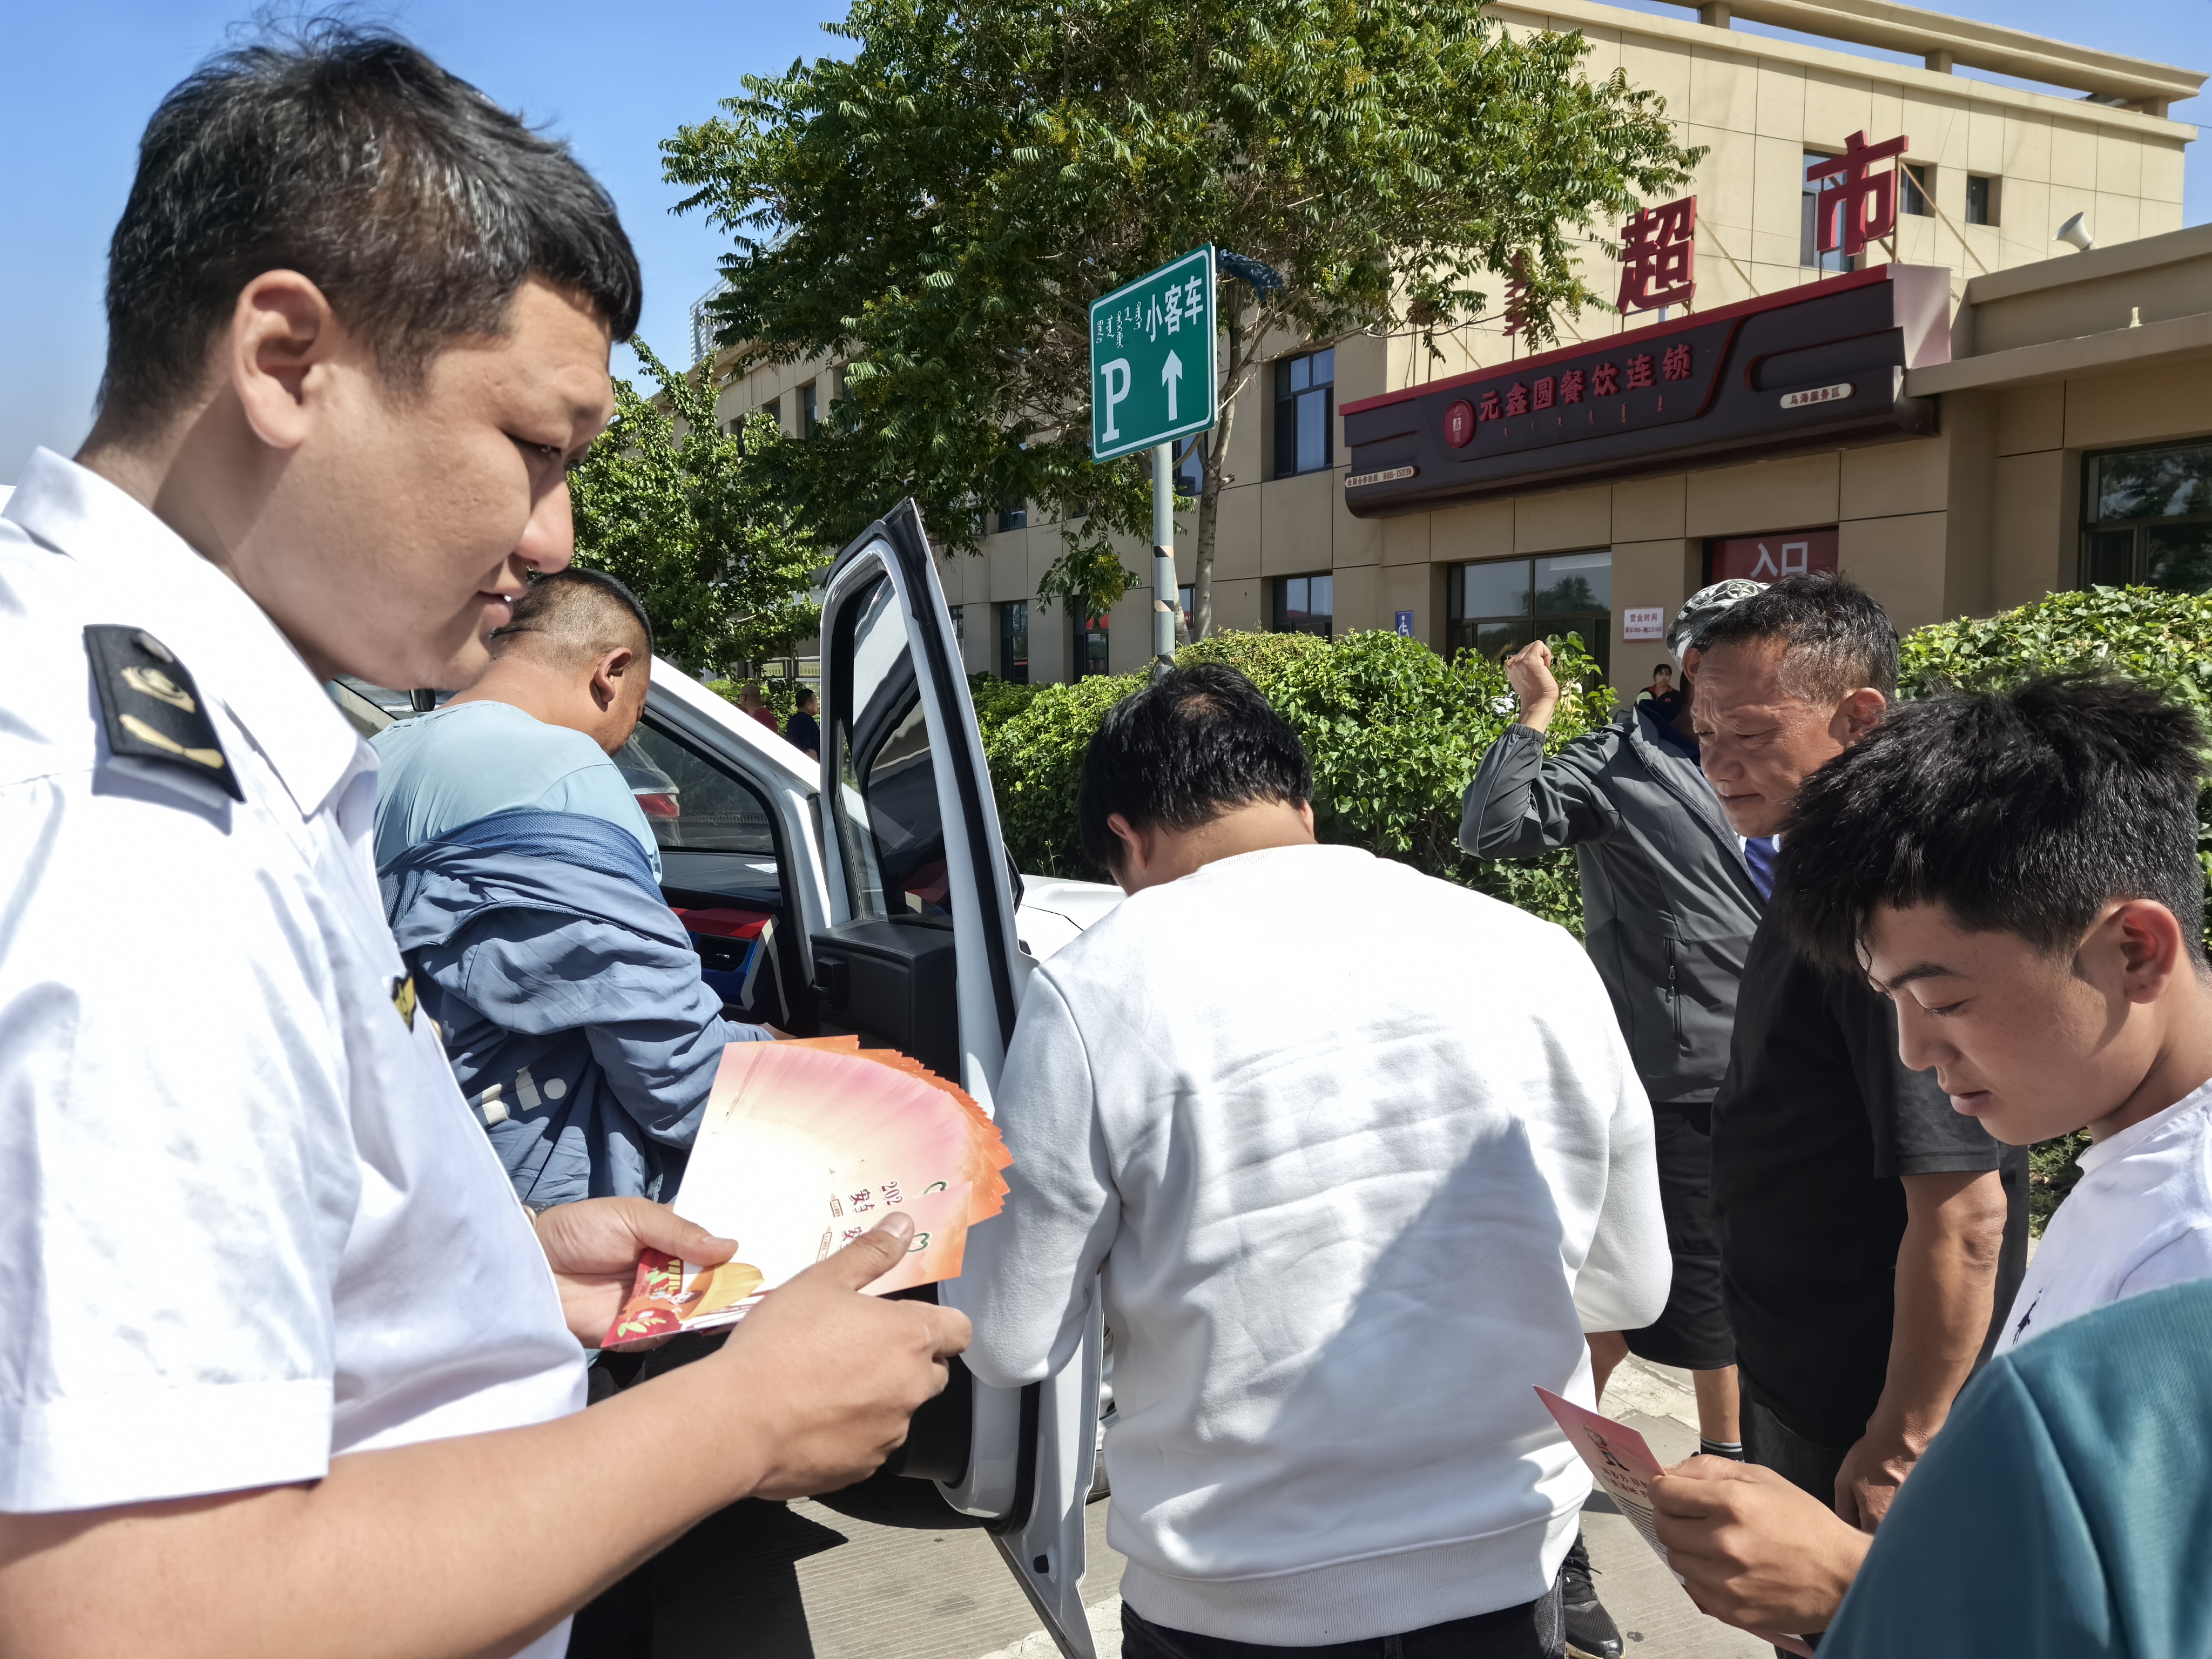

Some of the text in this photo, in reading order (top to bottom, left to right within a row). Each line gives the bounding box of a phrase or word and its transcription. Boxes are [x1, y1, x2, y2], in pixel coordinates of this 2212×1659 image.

[1145, 275, 1204, 342] 小客车
[1101, 358, 1131, 443] P
[1479, 344, 1692, 421] 元鑫圆餐饮连锁
[1750, 542, 1808, 578] 入口
[1630, 612, 1657, 623] 营业时间
